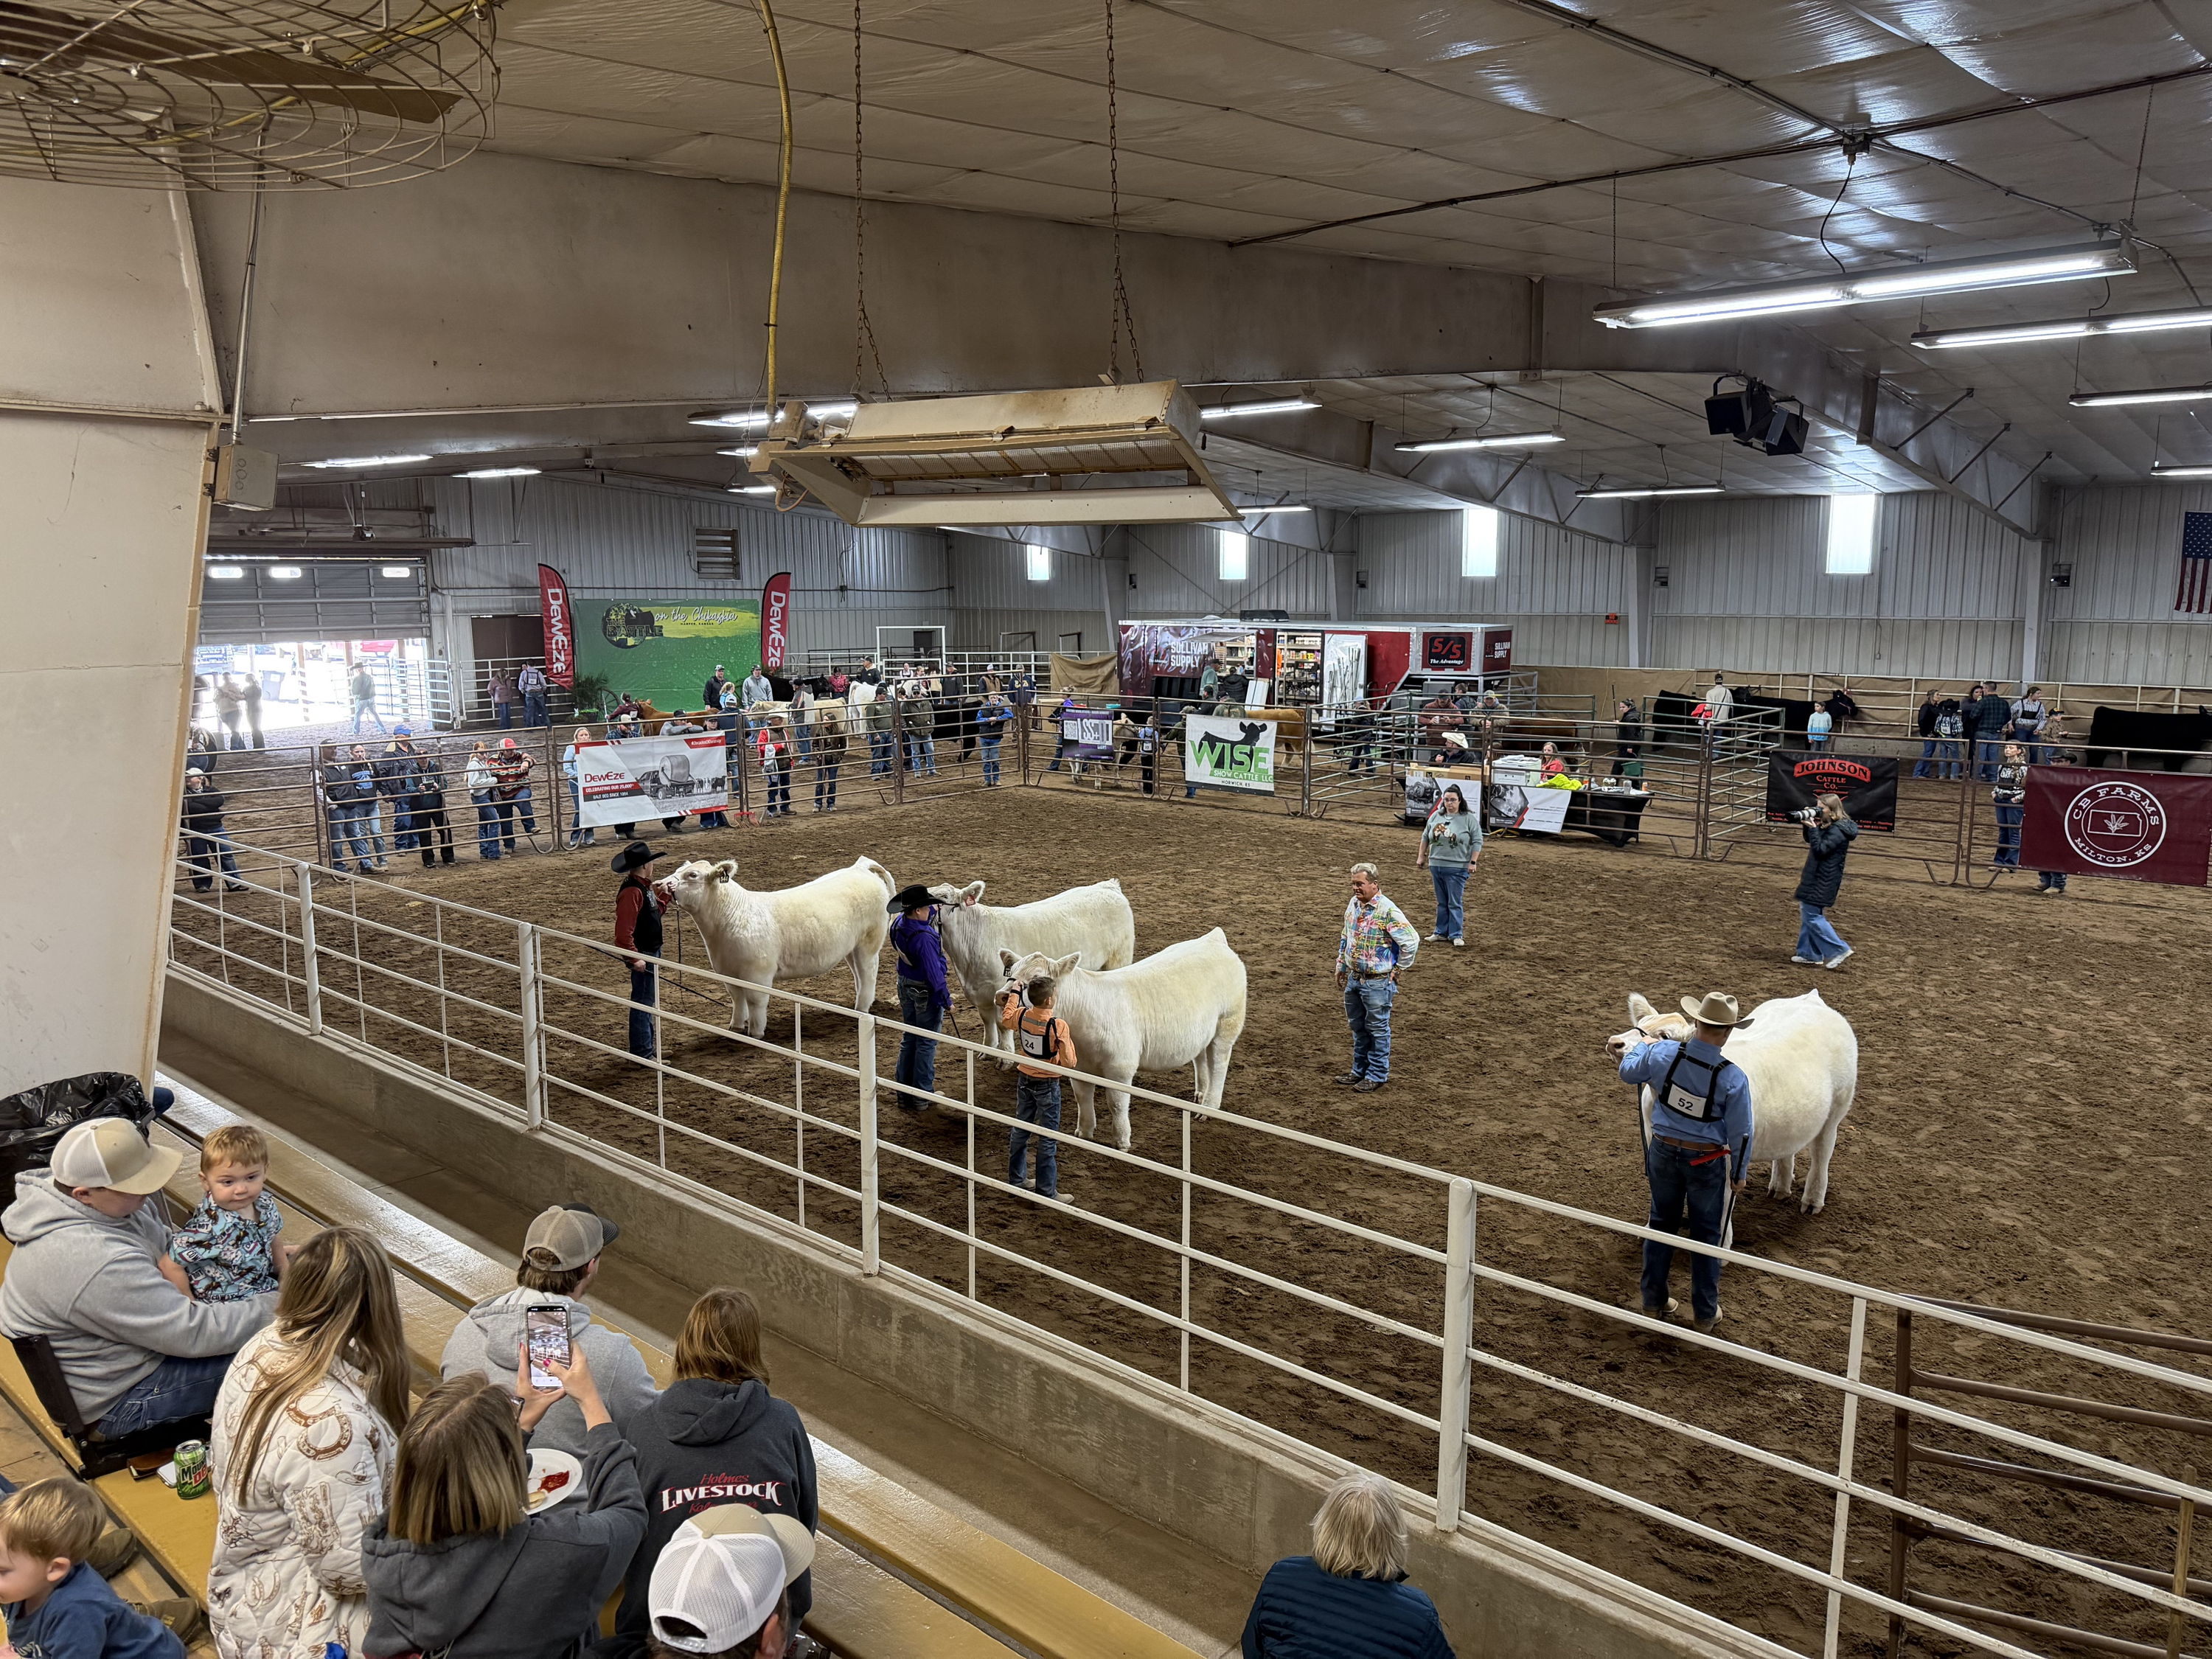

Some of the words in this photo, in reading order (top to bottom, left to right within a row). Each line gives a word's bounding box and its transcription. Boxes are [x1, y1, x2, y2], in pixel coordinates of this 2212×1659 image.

[655, 613, 668, 622] on
[671, 606, 688, 622] the
[607, 625, 664, 637] BATTLE
[1171, 641, 1208, 655] SULLIVAN
[1170, 655, 1200, 667] SUPPLY
[1188, 740, 1270, 774] WISE
[1233, 771, 1259, 781] CATTLE
[1262, 774, 1274, 782] LLC
[1797, 761, 1868, 779] JOHNSON
[2073, 797, 2091, 820] CB
[2097, 787, 2160, 826] FARMS
[2135, 844, 2152, 858] KS
[1025, 1039, 1034, 1050] 24
[1677, 1097, 1694, 1111] 52
[186, 1249, 201, 1262] COW
[700, 1472, 749, 1484] Holmes
[661, 1481, 785, 1513] LIVESTOCK
